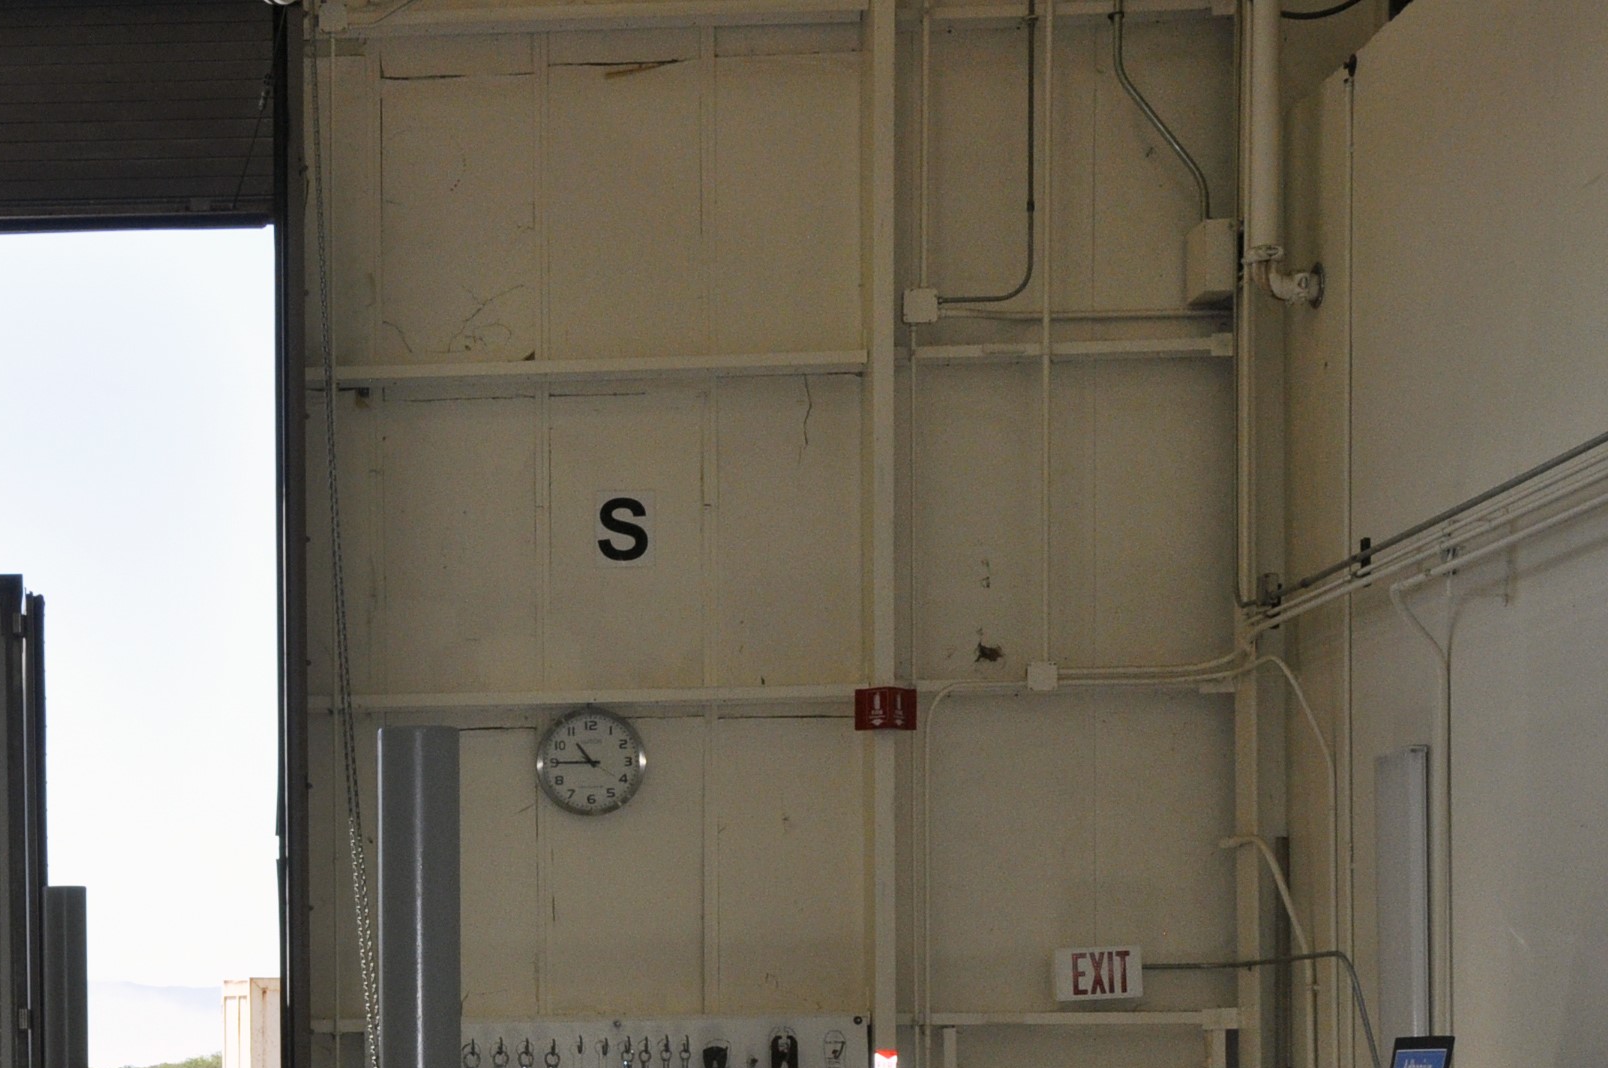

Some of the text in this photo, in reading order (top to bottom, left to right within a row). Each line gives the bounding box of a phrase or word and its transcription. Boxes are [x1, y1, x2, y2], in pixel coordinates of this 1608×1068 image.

[598, 497, 648, 561] S
[584, 720, 597, 731] 12
[567, 726, 575, 736] 11
[554, 740, 566, 750] 10
[618, 739, 627, 749] 2
[550, 757, 559, 768] 9
[624, 756, 632, 766] 3
[555, 775, 564, 785] 8
[619, 773, 628, 783] 4
[567, 789, 575, 799] 7
[607, 788, 615, 797] 5
[587, 794, 596, 804] 6
[1071, 950, 1130, 995] EXIT
